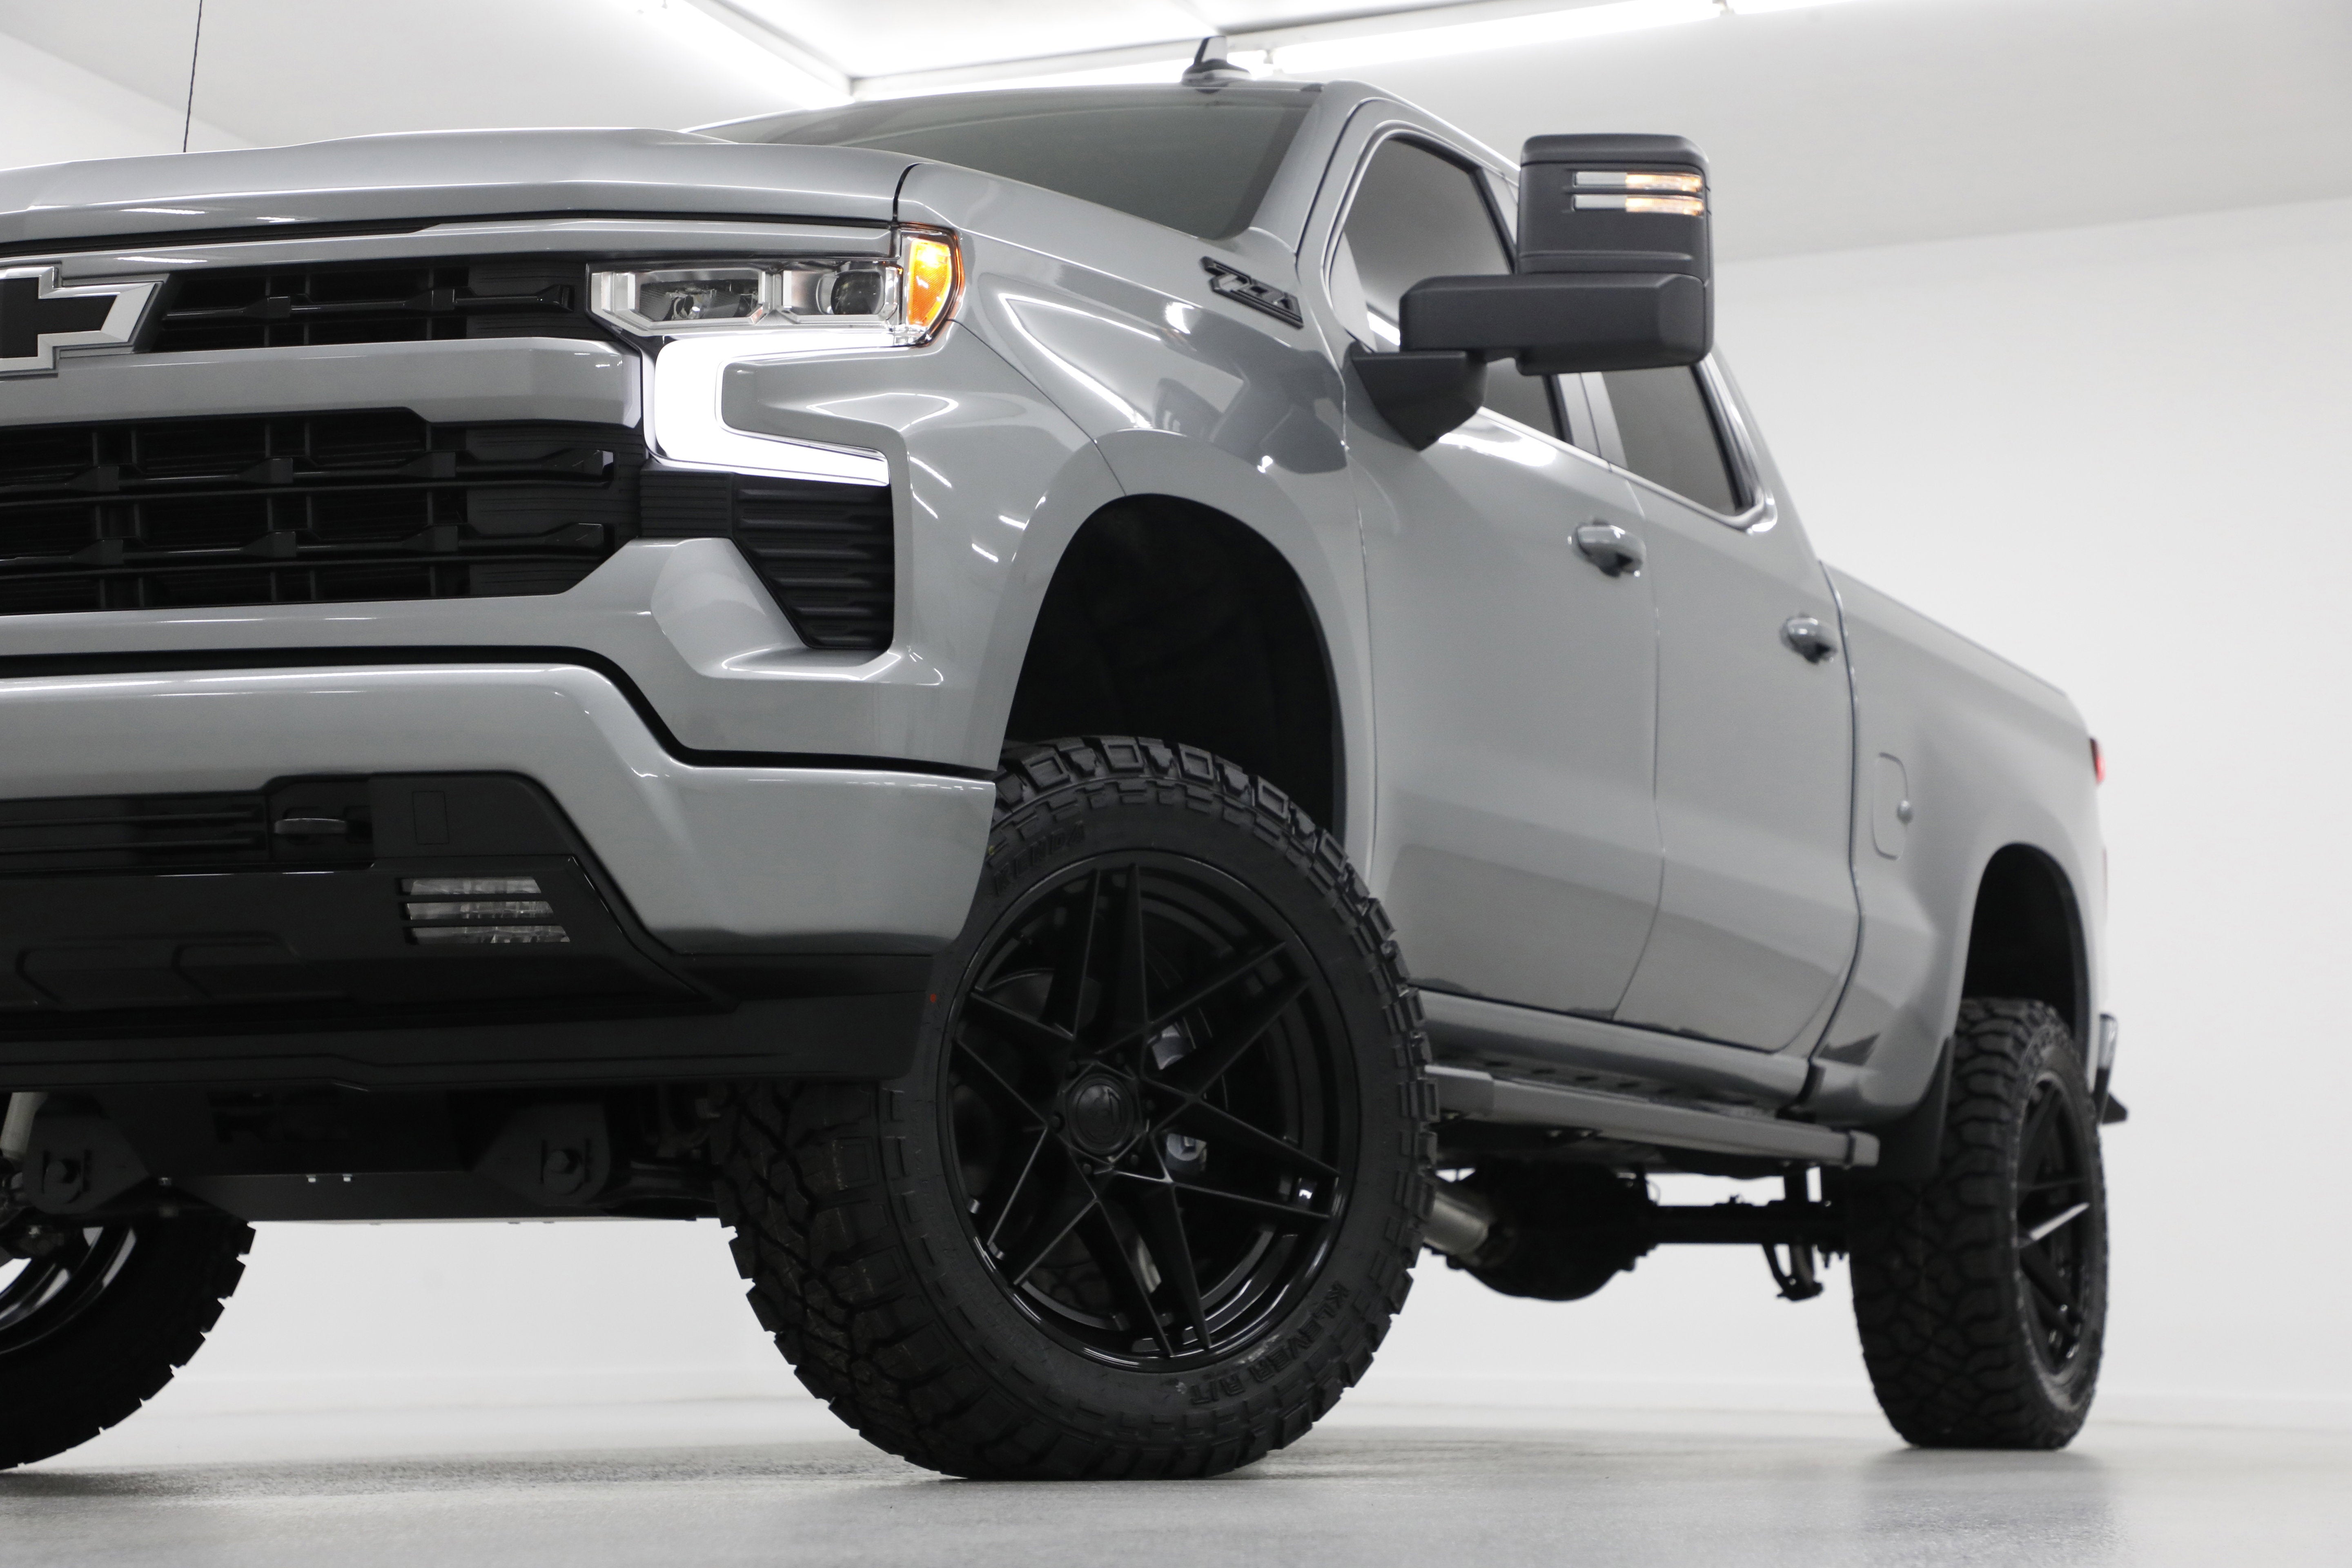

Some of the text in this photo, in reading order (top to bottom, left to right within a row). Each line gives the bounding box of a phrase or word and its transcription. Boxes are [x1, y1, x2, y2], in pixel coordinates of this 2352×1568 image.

[1199, 256, 1303, 329] Z71
[993, 820, 1086, 896] KENDA
[1247, 1281, 1348, 1383] KLEVER
